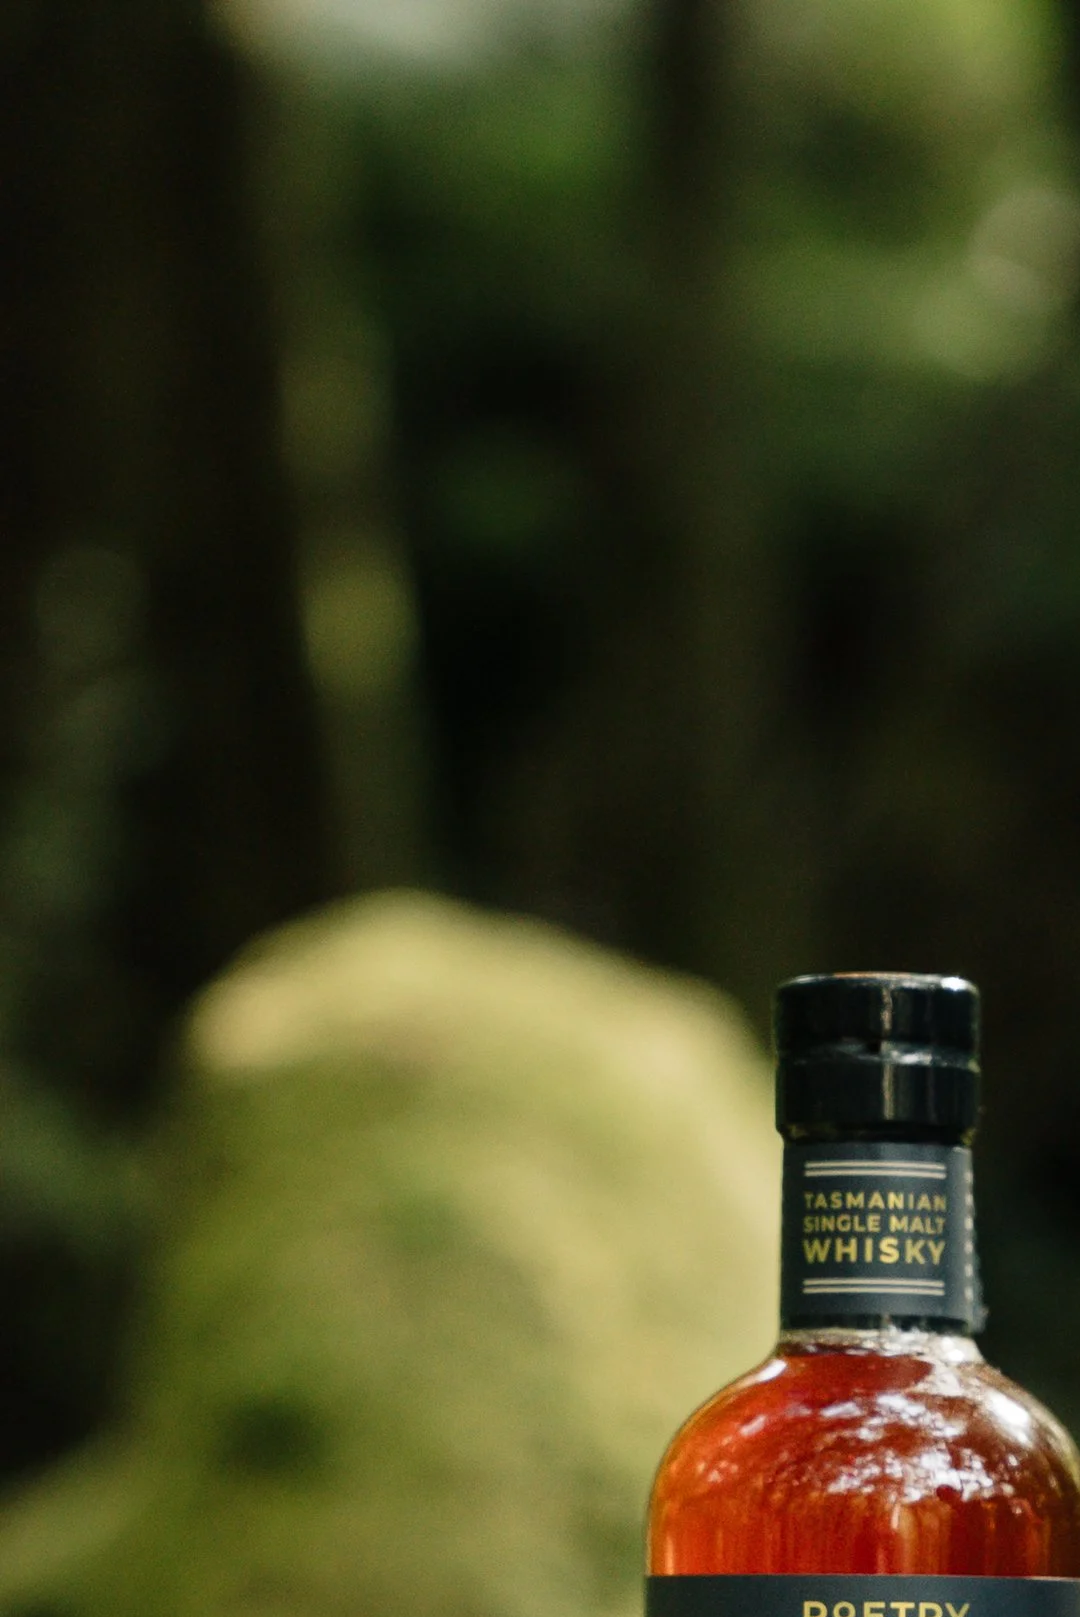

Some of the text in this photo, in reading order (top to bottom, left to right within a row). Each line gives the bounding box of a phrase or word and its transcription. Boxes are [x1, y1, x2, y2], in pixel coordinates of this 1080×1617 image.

[803, 1190, 946, 1212] TASMANIAN
[803, 1213, 946, 1235] SINGLE MALT
[802, 1236, 946, 1265] WHISKY
